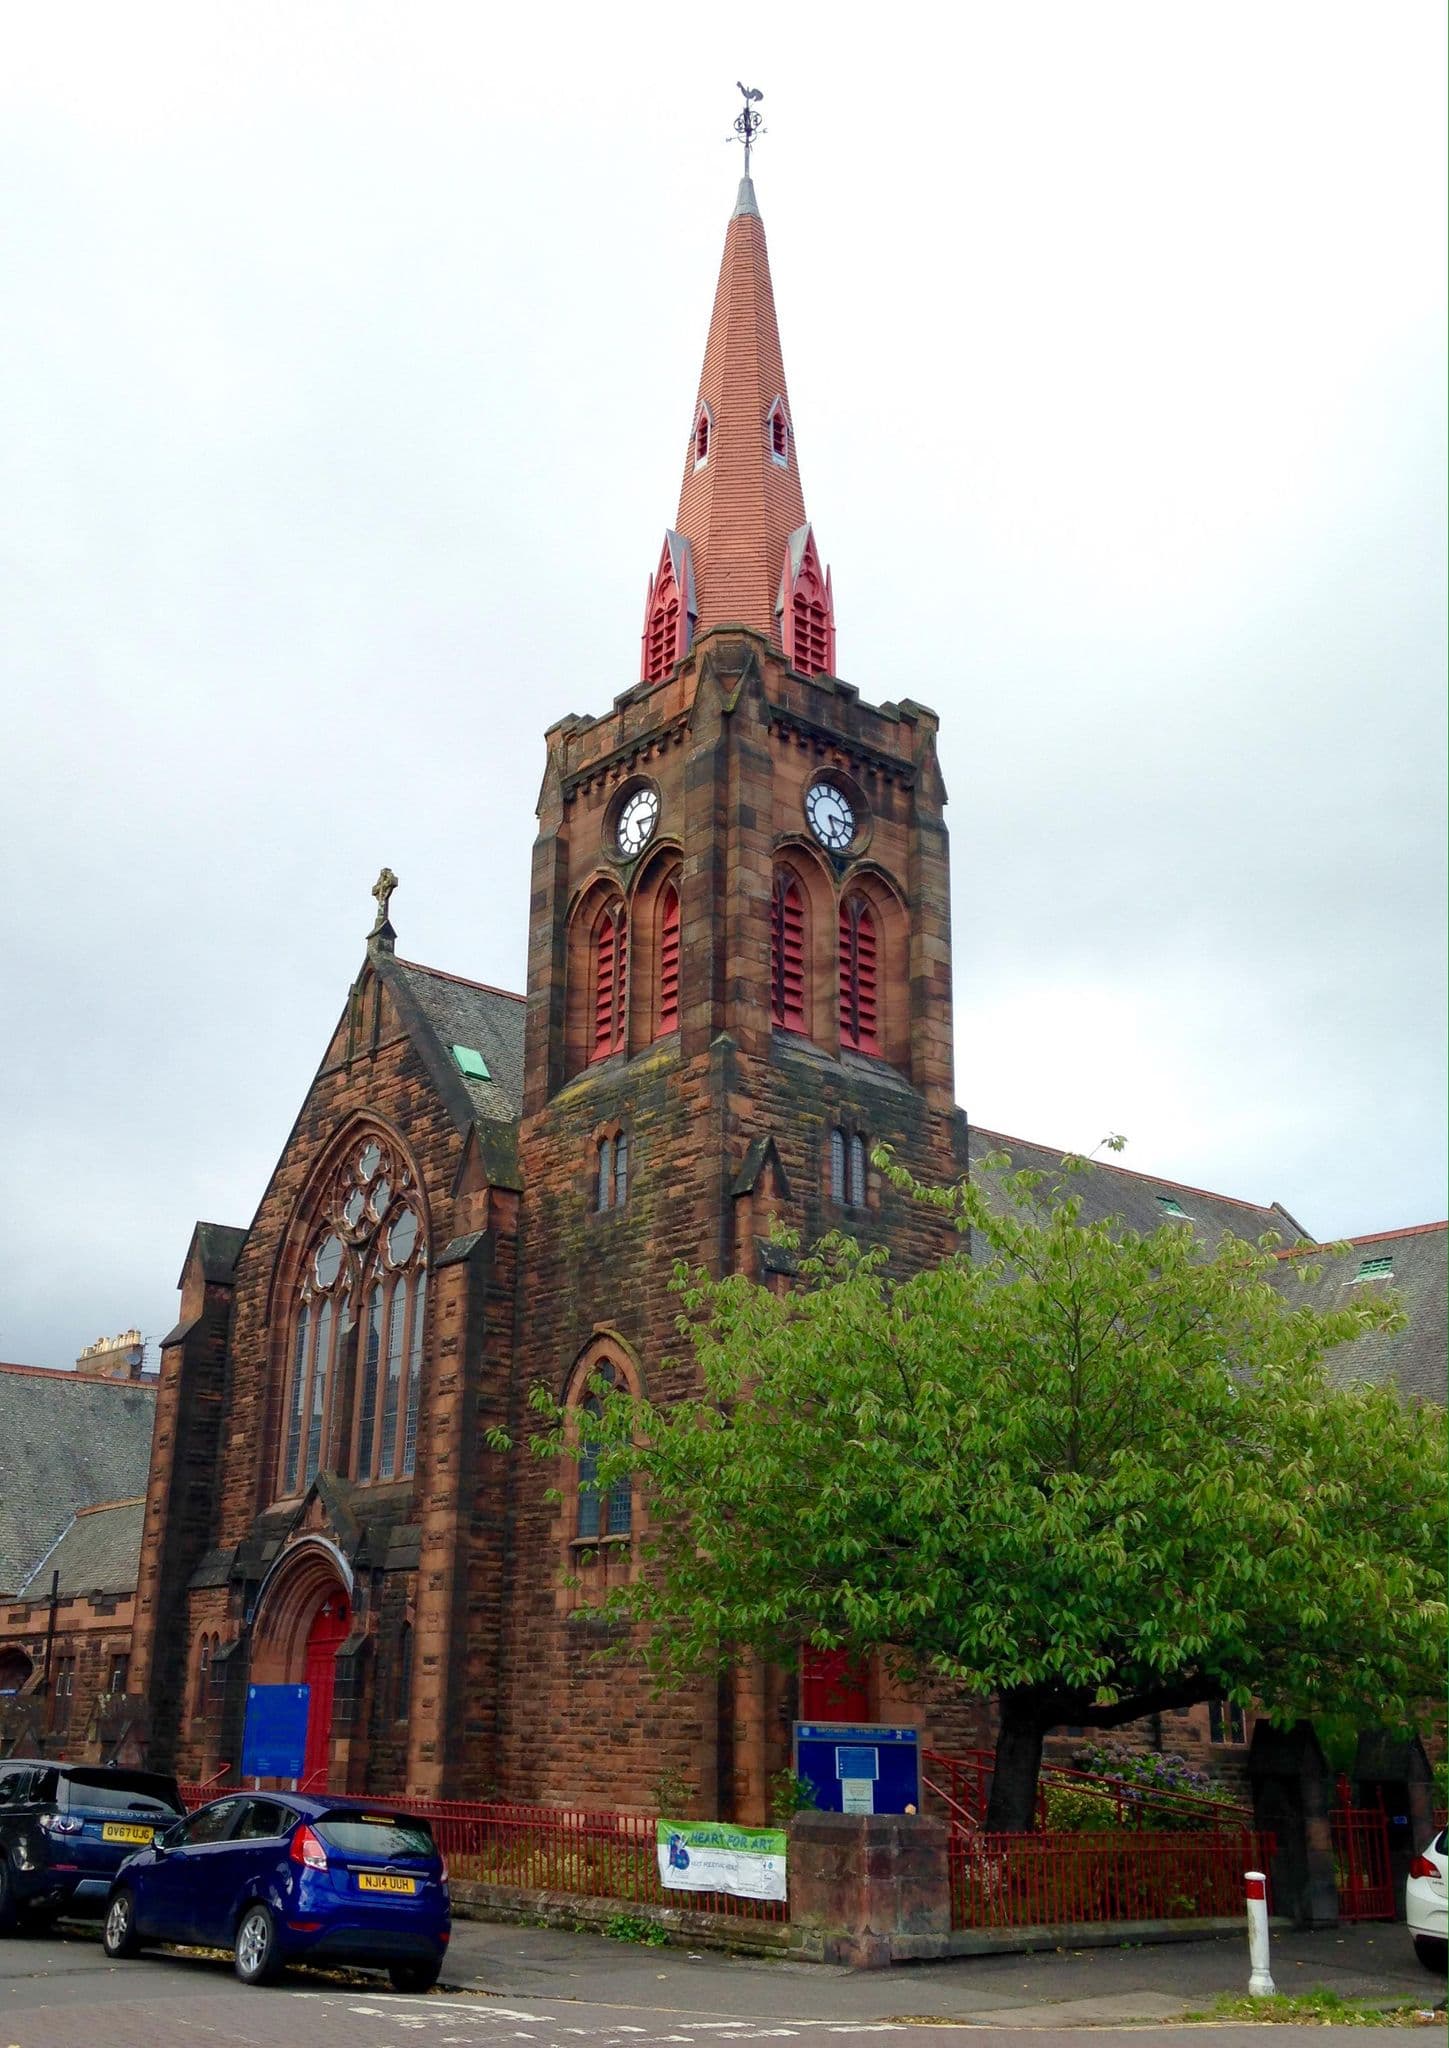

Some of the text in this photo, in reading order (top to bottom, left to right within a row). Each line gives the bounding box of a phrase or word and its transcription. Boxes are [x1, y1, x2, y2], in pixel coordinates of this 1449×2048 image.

[98, 1809, 162, 1819] DISCOVERY
[691, 1831, 774, 1851] HEART FOR ART
[365, 1876, 409, 1890] NJ14 UUH
